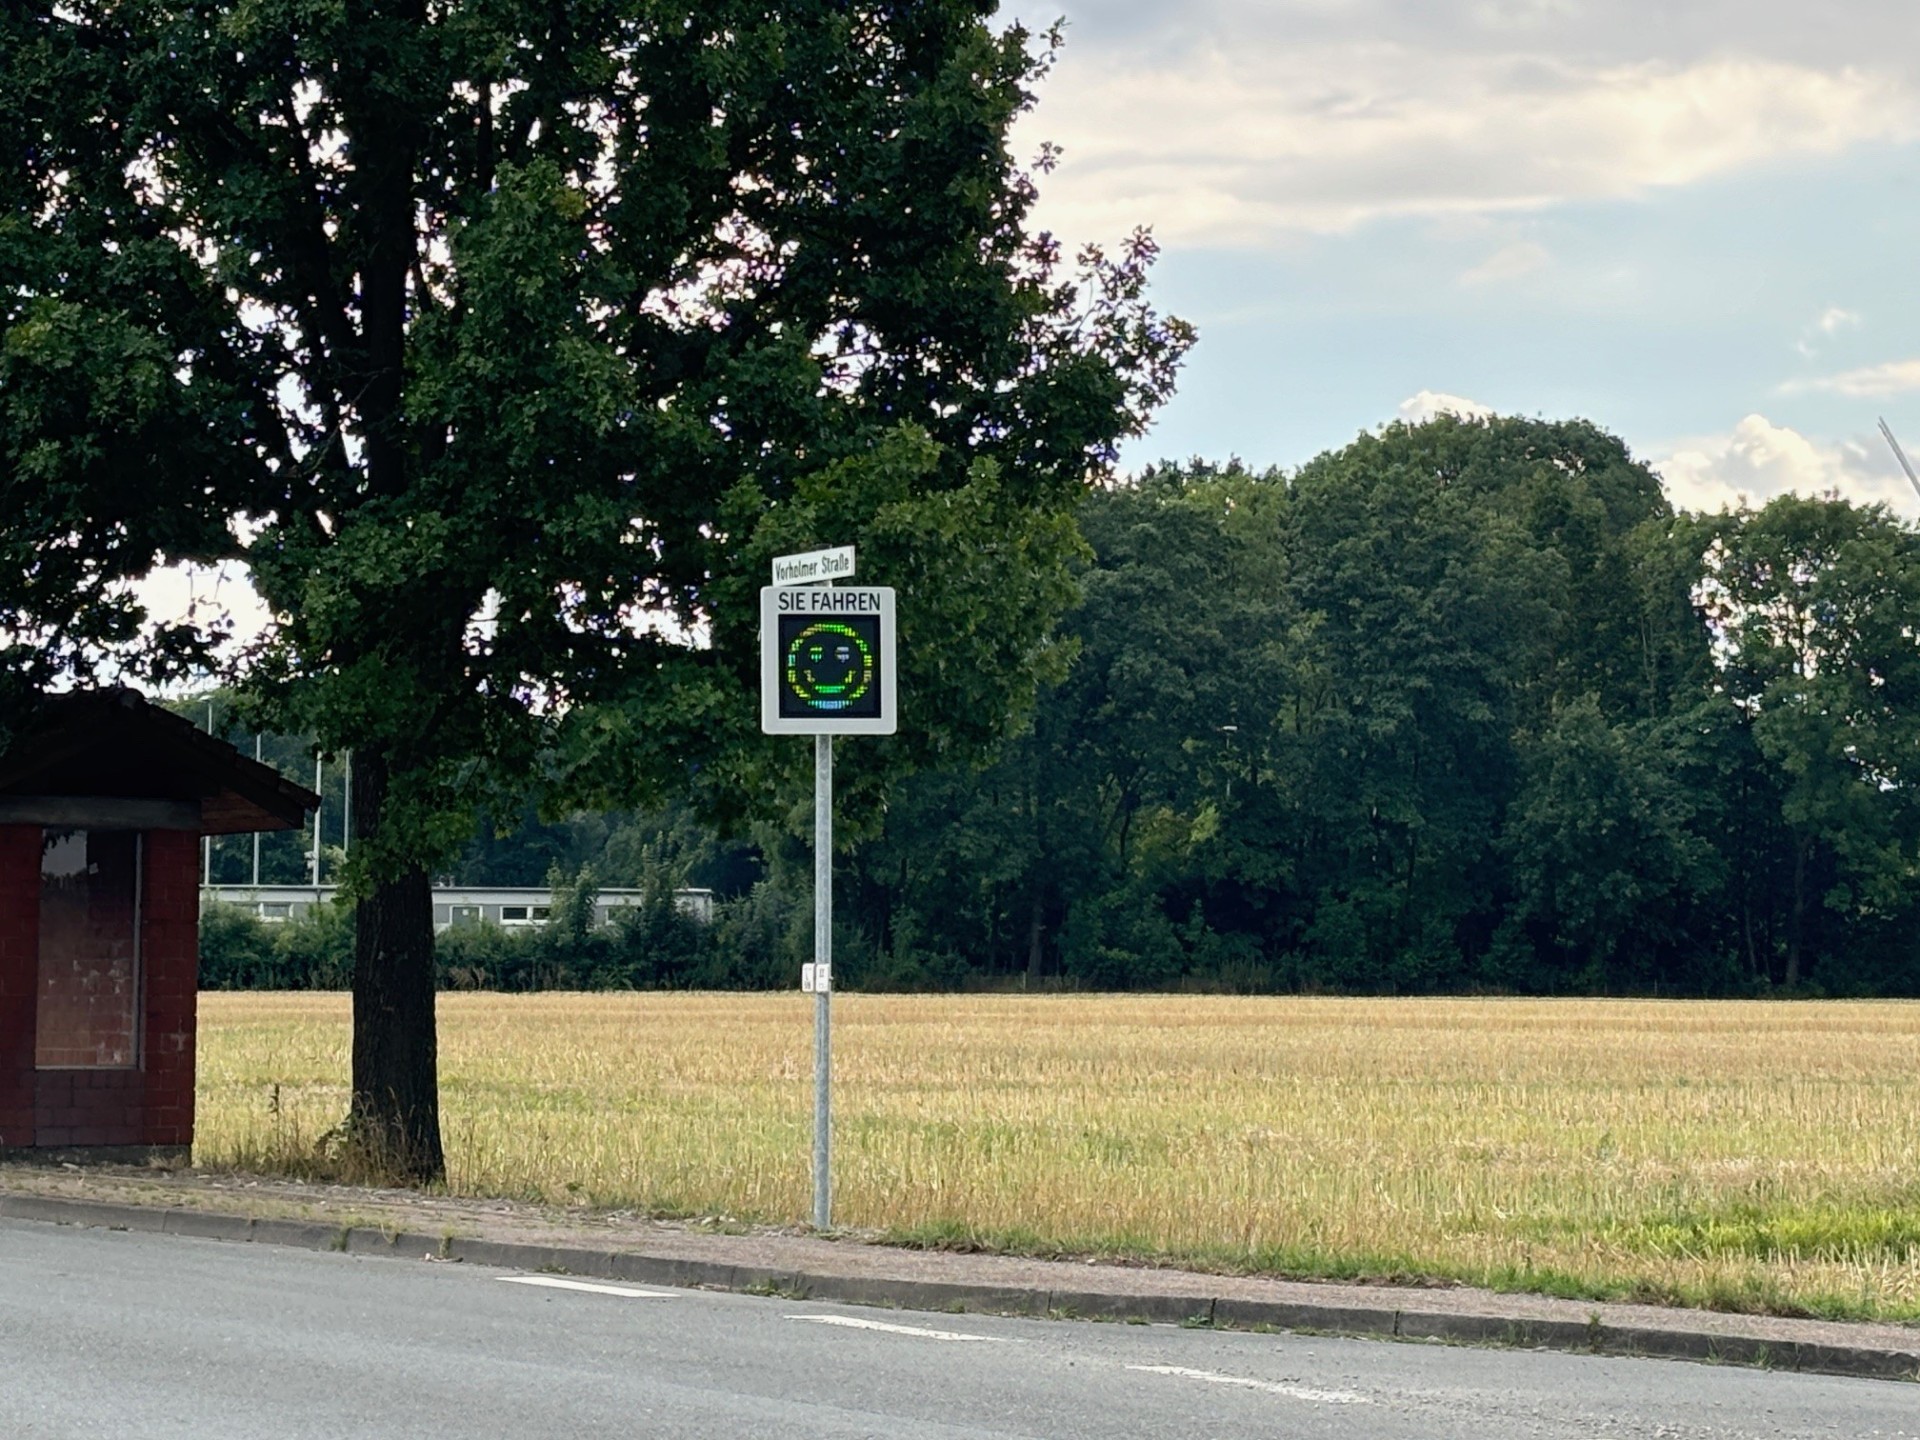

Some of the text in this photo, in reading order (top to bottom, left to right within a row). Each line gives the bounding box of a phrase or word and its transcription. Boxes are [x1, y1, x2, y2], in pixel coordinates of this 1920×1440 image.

[821, 553, 849, 574] Straße
[778, 592, 880, 611] SIE FAHREN
